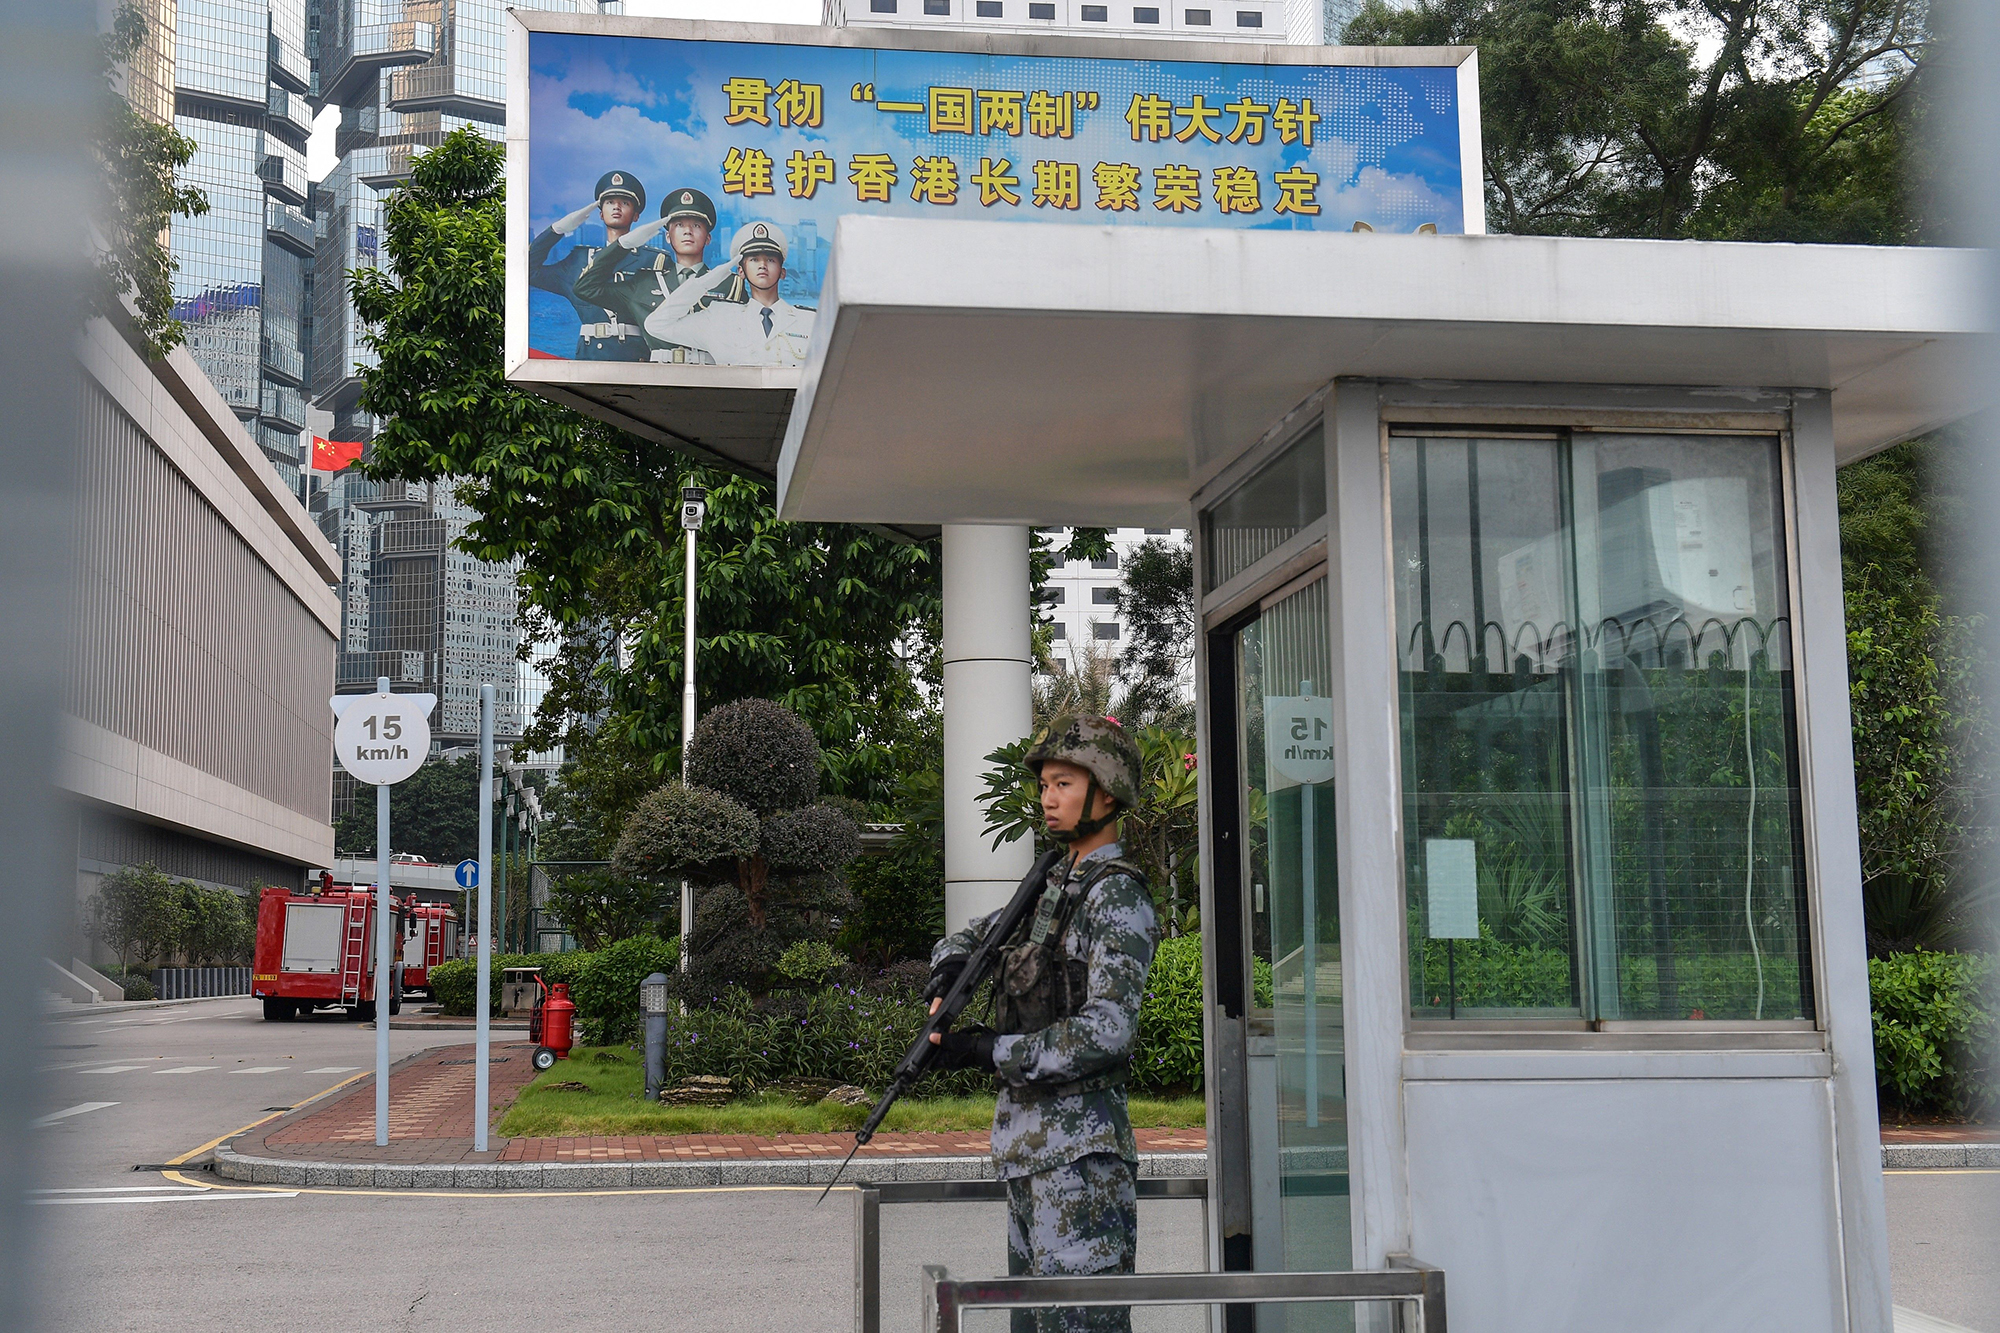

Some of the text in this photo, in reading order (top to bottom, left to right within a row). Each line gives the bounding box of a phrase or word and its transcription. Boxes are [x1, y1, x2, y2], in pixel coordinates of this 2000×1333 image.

[722, 77, 823, 127] 贯彻
[1124, 93, 1320, 146] 伟大方针
[722, 147, 1321, 214] 维护香港长期繁荣稳定
[363, 715, 402, 740] 15
[357, 745, 408, 760] km/h
